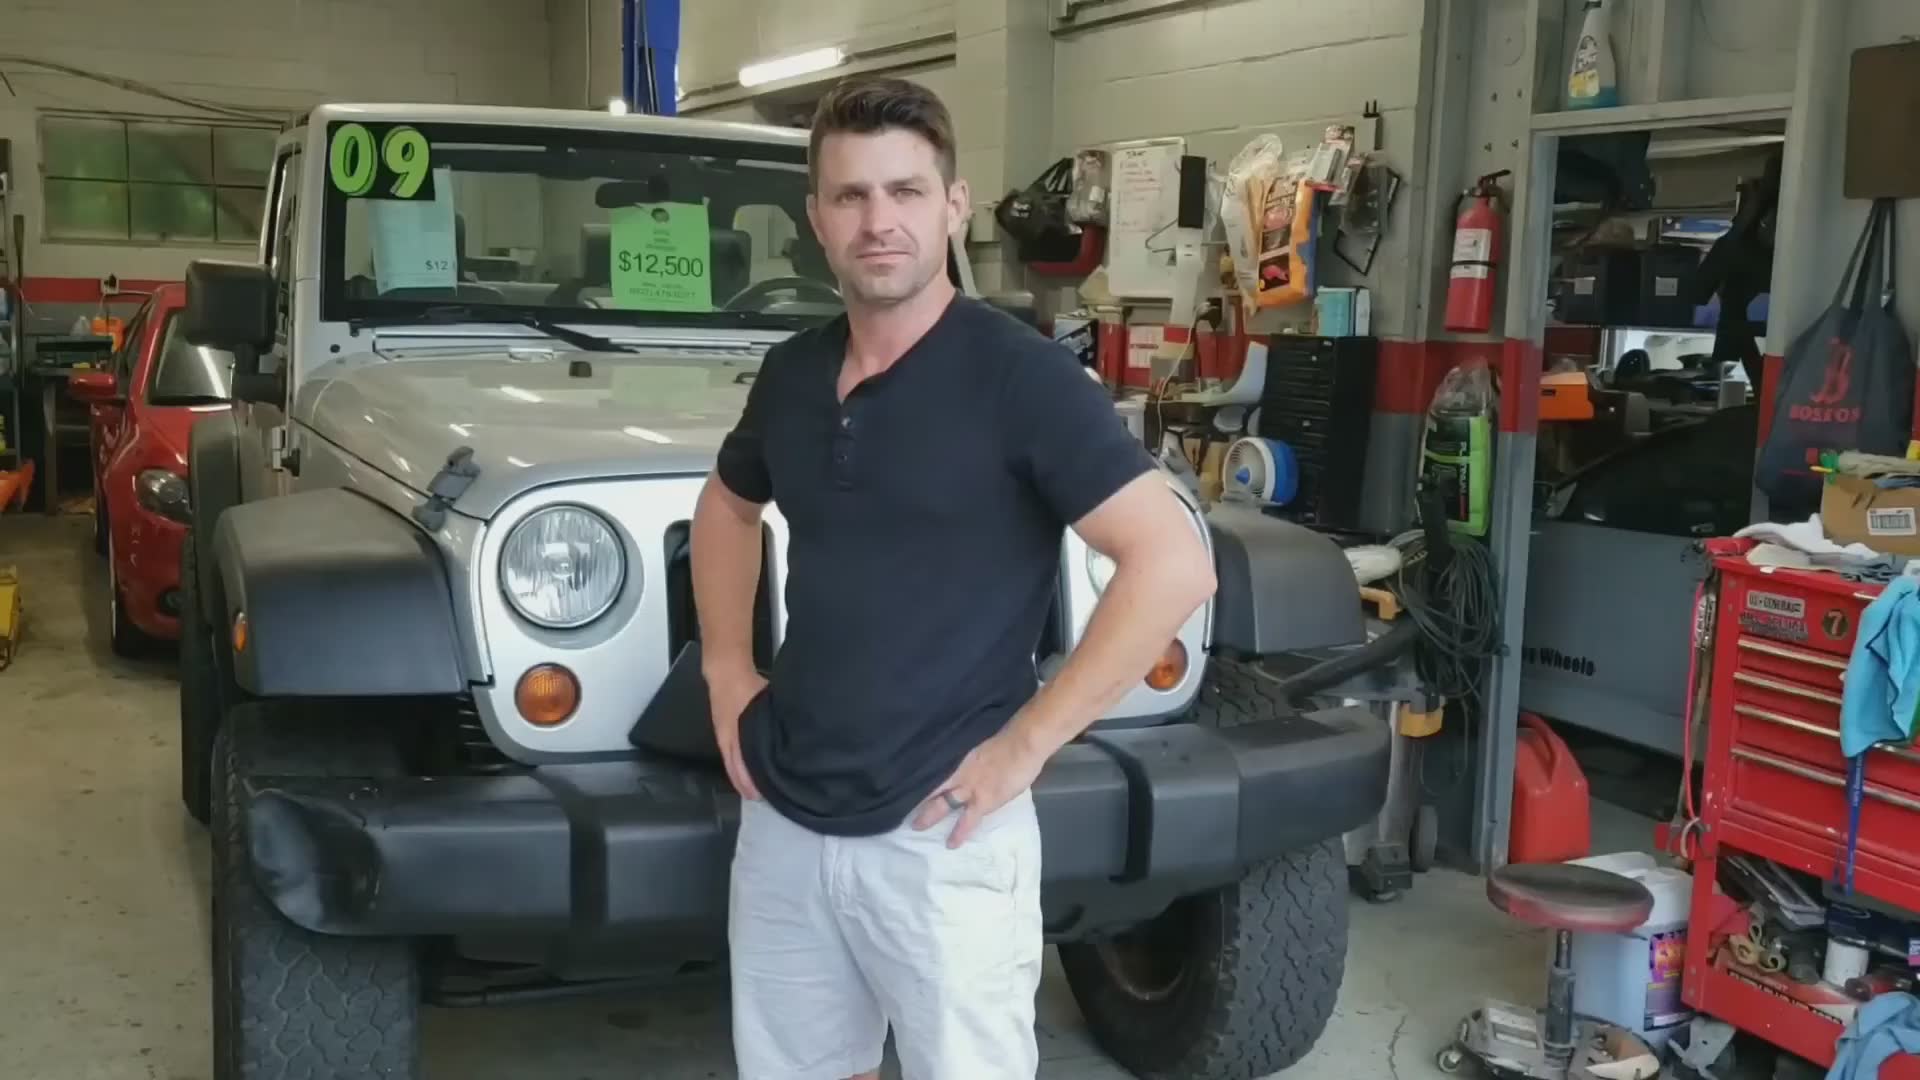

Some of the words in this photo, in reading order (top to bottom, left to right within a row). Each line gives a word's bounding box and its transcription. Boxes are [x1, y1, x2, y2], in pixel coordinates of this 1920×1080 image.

[330, 123, 430, 198] 09
[618, 250, 704, 278] $12,500
[1828, 611, 1842, 635] 7
